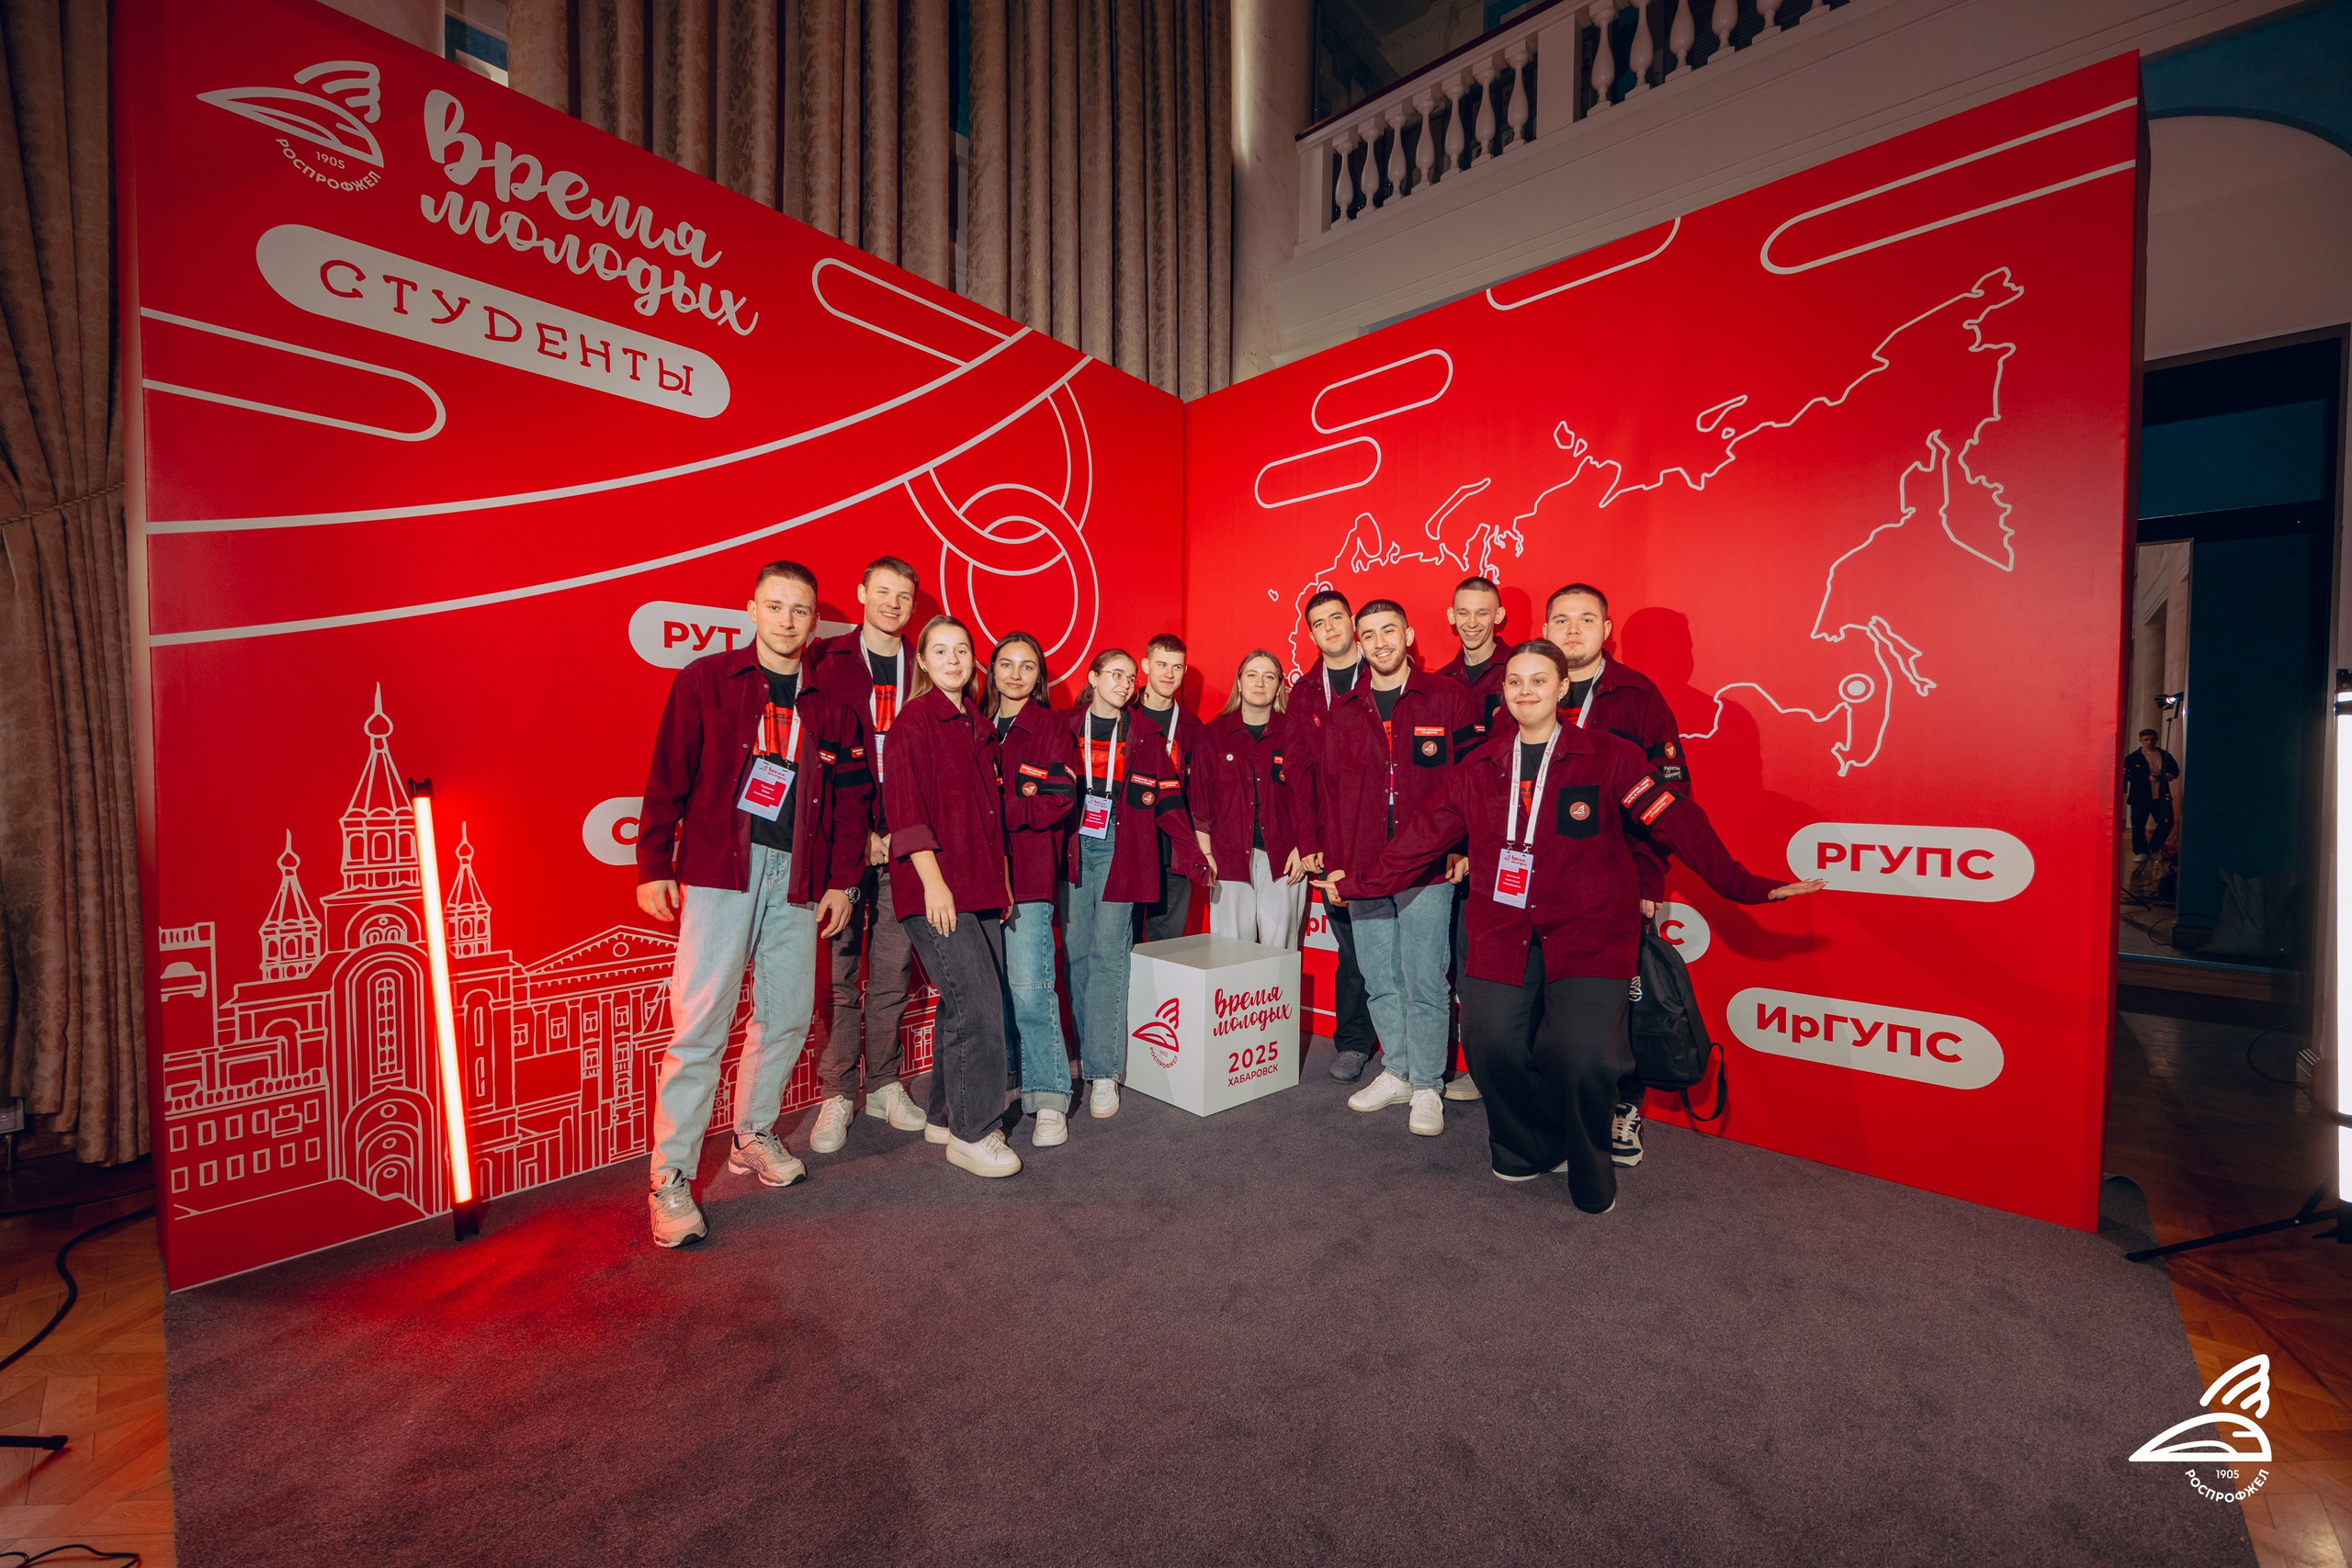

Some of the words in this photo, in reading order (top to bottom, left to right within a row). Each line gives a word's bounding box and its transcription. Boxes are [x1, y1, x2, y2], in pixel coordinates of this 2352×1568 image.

[276, 139, 381, 191] РОСПРОФЖЕЛ
[316, 151, 345, 169] 1905
[424, 89, 723, 268] время
[421, 191, 759, 335] молодых
[663, 620, 741, 652] РУТ
[1816, 841, 1996, 880] РГУПС
[1659, 919, 1685, 946] С
[1214, 986, 1283, 1019] время
[1213, 1003, 1293, 1037] молодых
[1757, 1002, 1963, 1063] ИрГУПС
[1149, 1046, 1179, 1068] РОСПРОФЖЕЛ
[1227, 1041, 1279, 1074] 2025
[1227, 1063, 1279, 1088] ХАБАРОВСК
